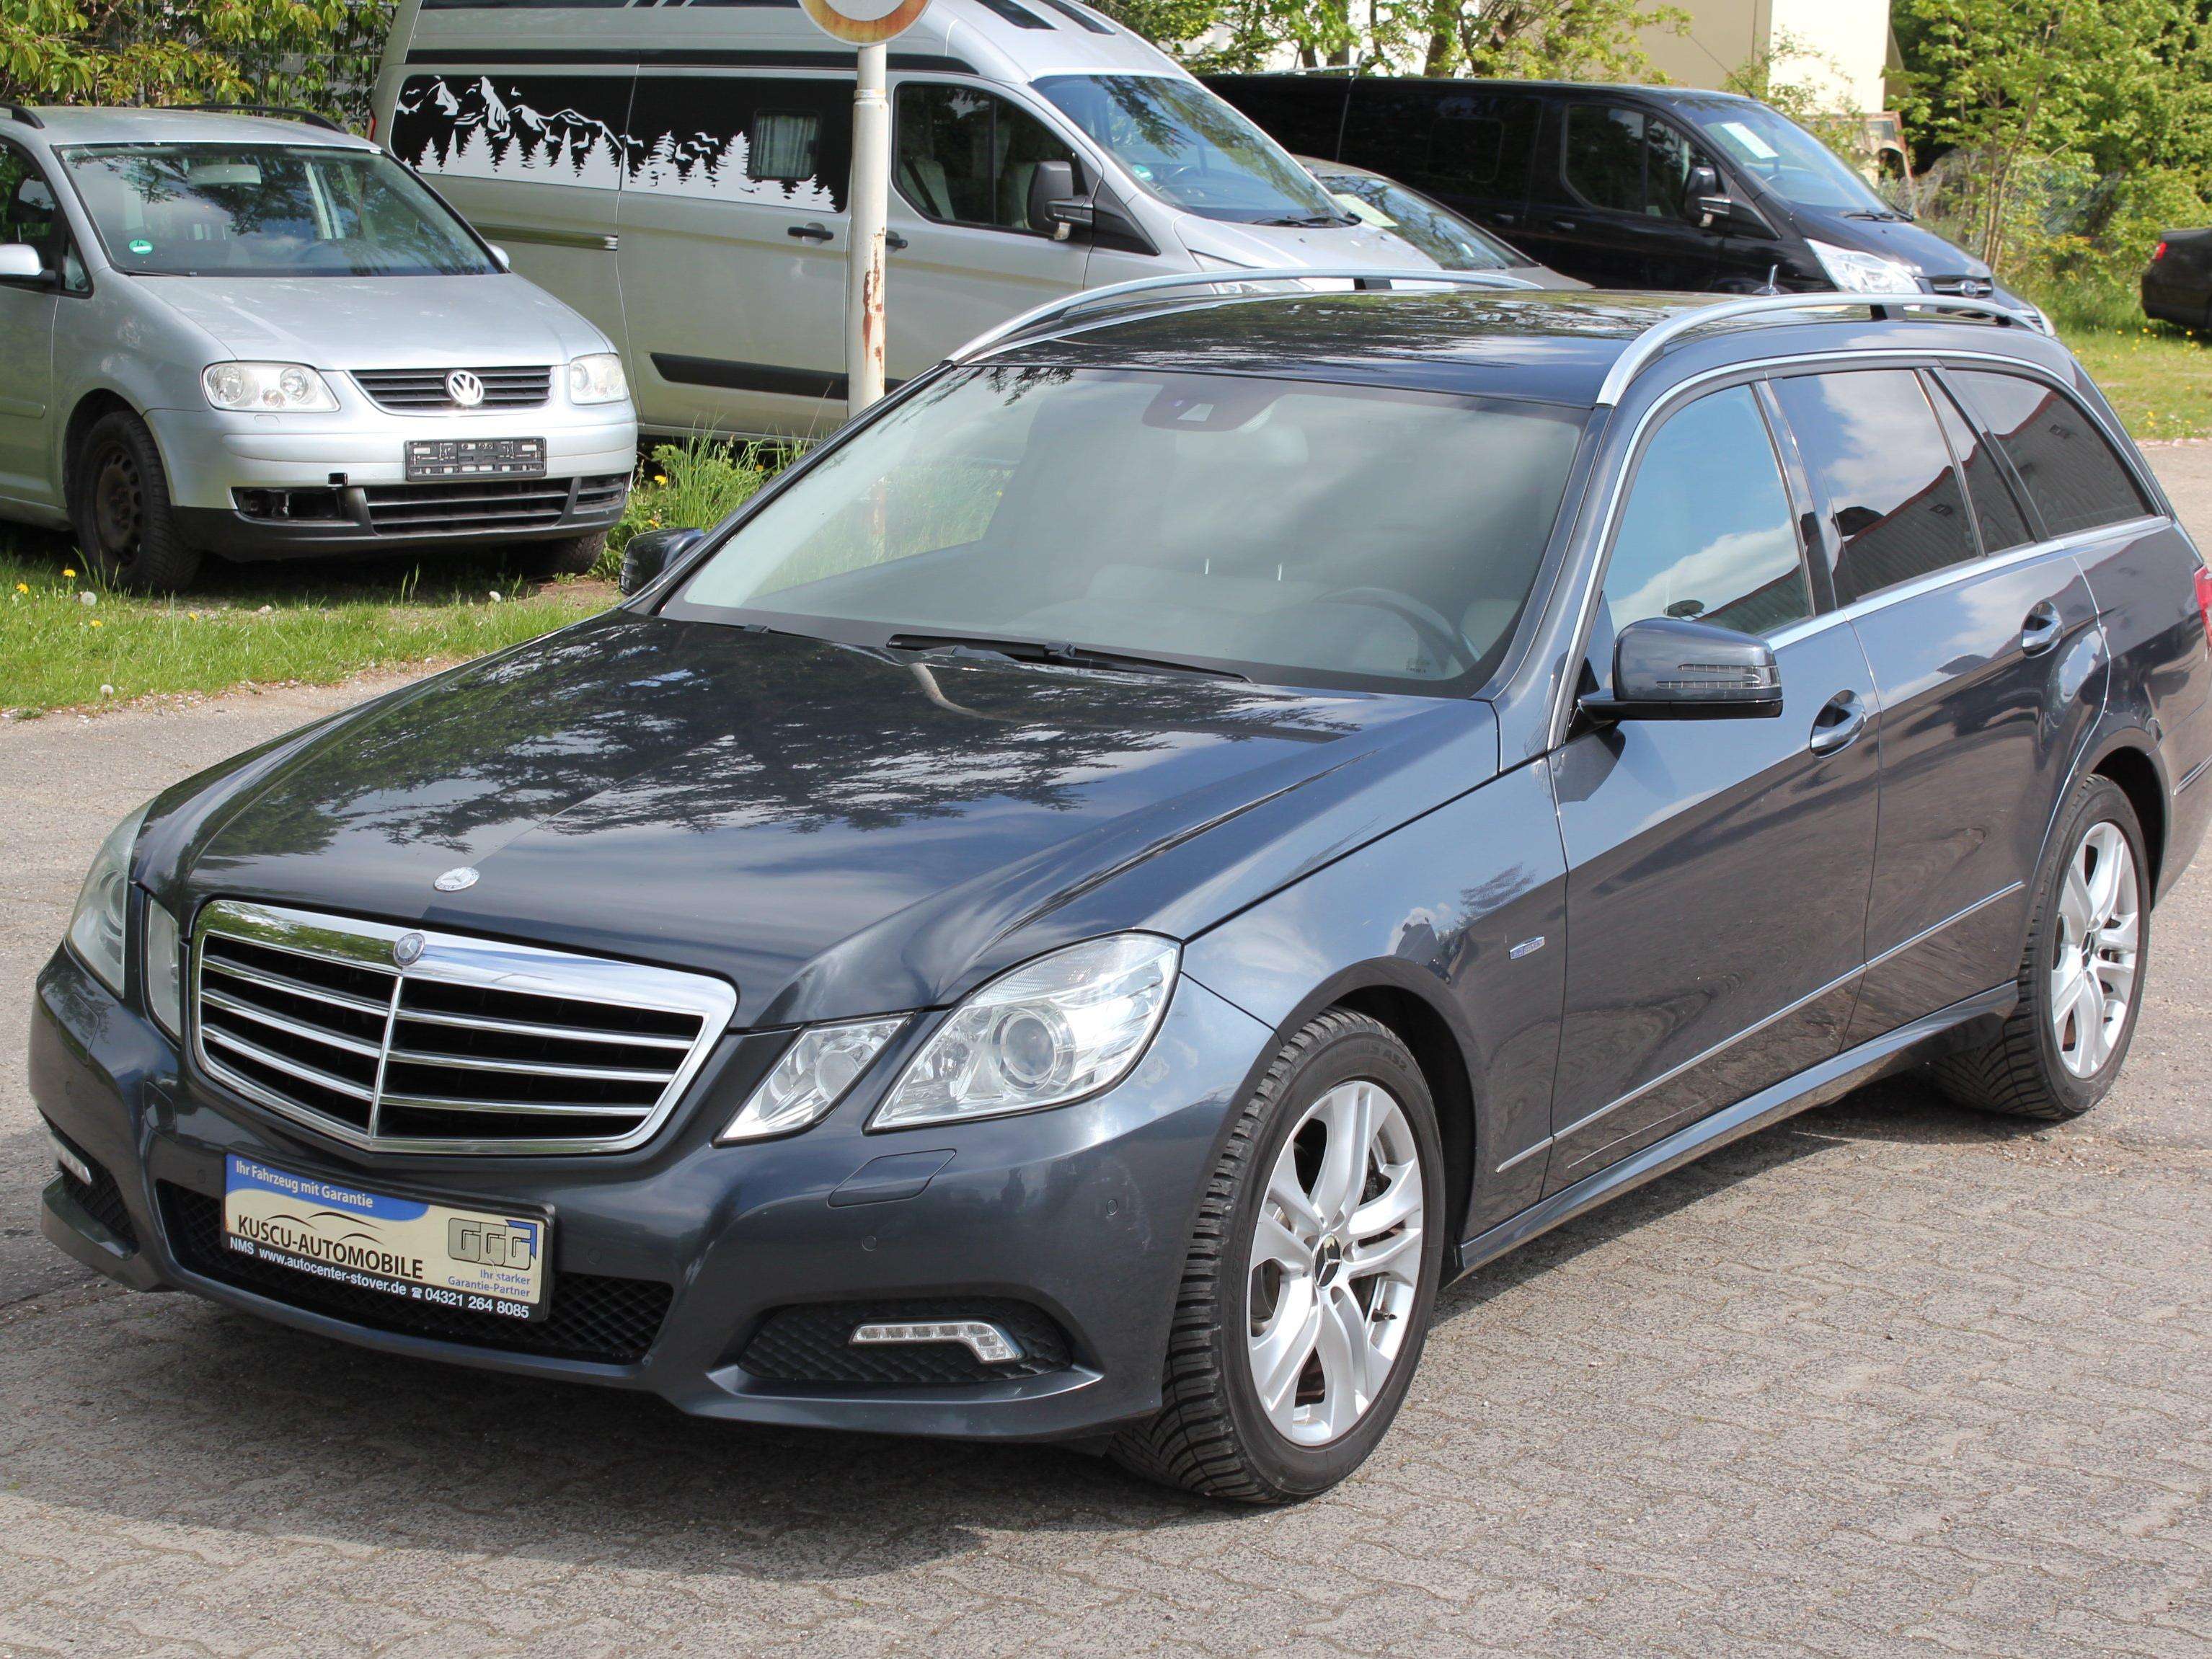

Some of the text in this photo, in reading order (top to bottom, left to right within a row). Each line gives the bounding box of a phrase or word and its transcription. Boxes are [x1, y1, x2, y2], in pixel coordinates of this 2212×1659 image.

[448, 371, 483, 404] VW
[236, 1160, 373, 1208] Ihr Fahrzeug mit Garantie
[238, 1214, 423, 1279] KUSCU-AUTOMOBILE
[230, 1236, 530, 1319] NMS www.autocenter-stover.de 04321 264 8085
[448, 1275, 531, 1297] Garantie-Partner
[480, 1269, 531, 1285] Ihr starker
